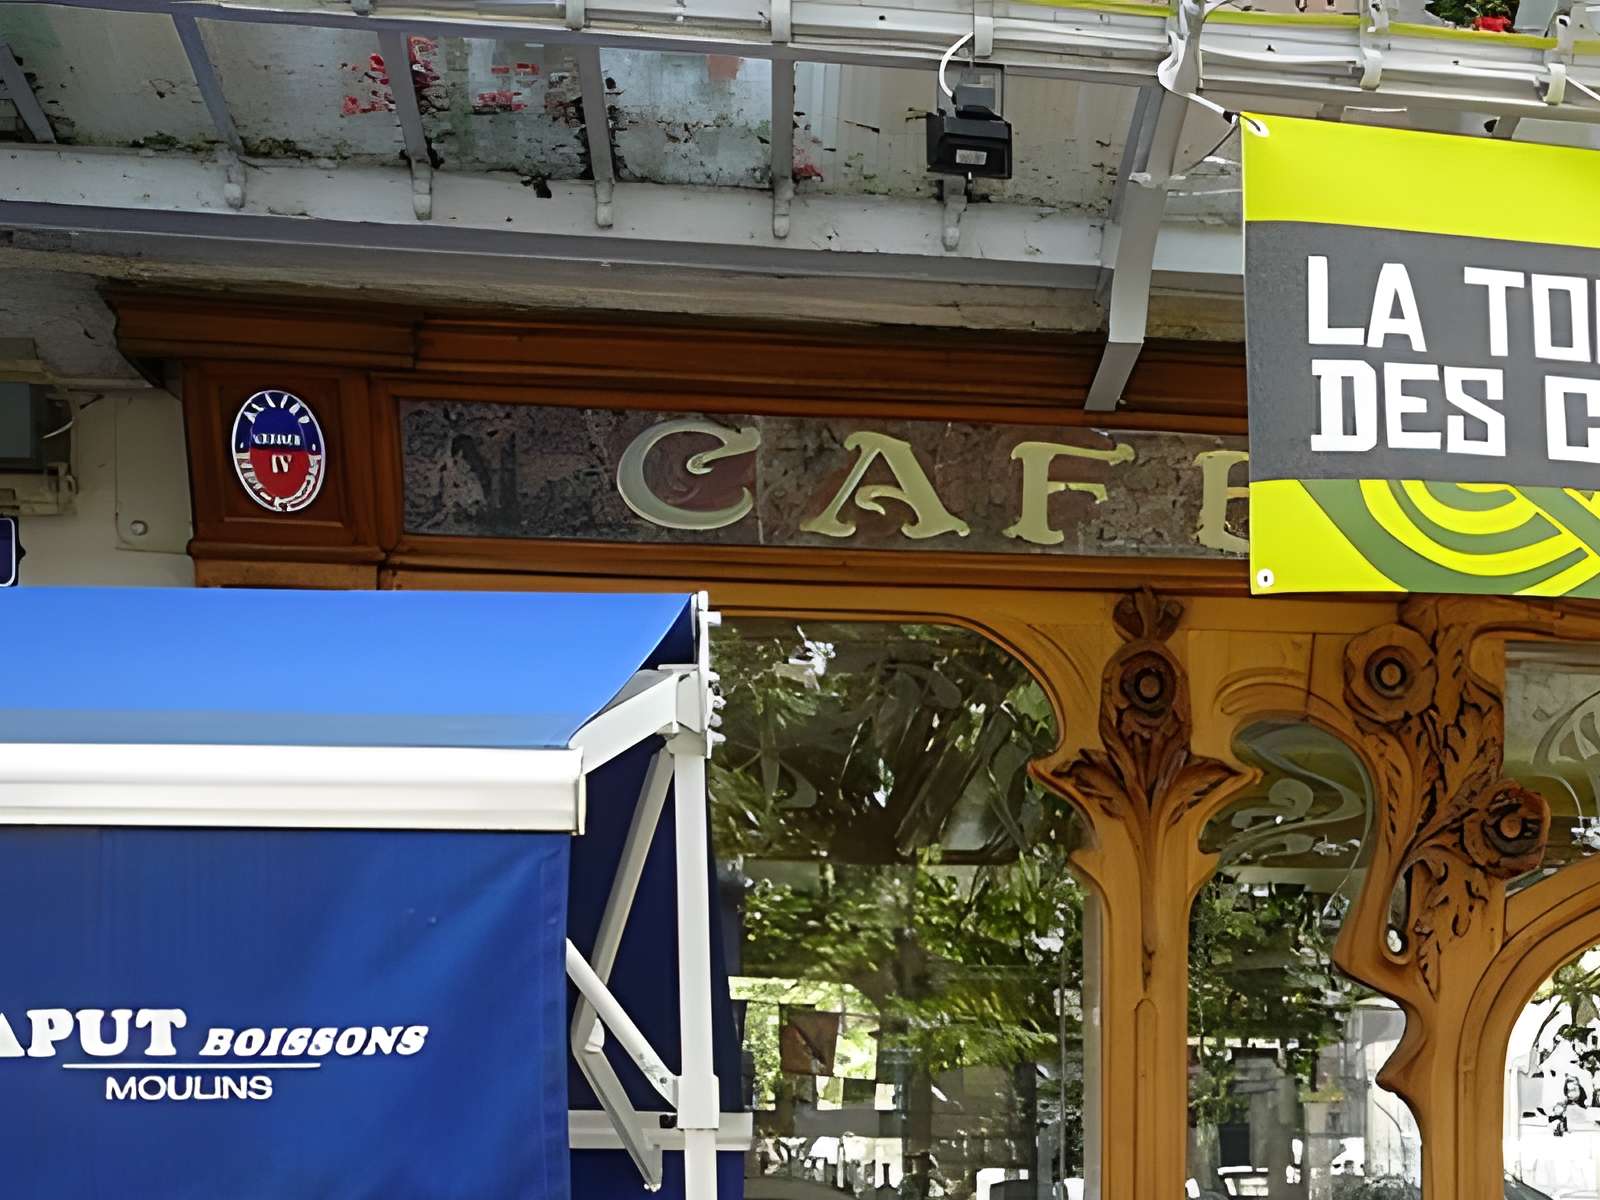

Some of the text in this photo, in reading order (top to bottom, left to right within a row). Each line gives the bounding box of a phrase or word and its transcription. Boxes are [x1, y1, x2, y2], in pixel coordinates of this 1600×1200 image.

[1306, 254, 1426, 352] LA
[1309, 358, 1507, 457] DES
[199, 1025, 430, 1057] BOISSONS
[105, 1074, 274, 1101] MOULINS
